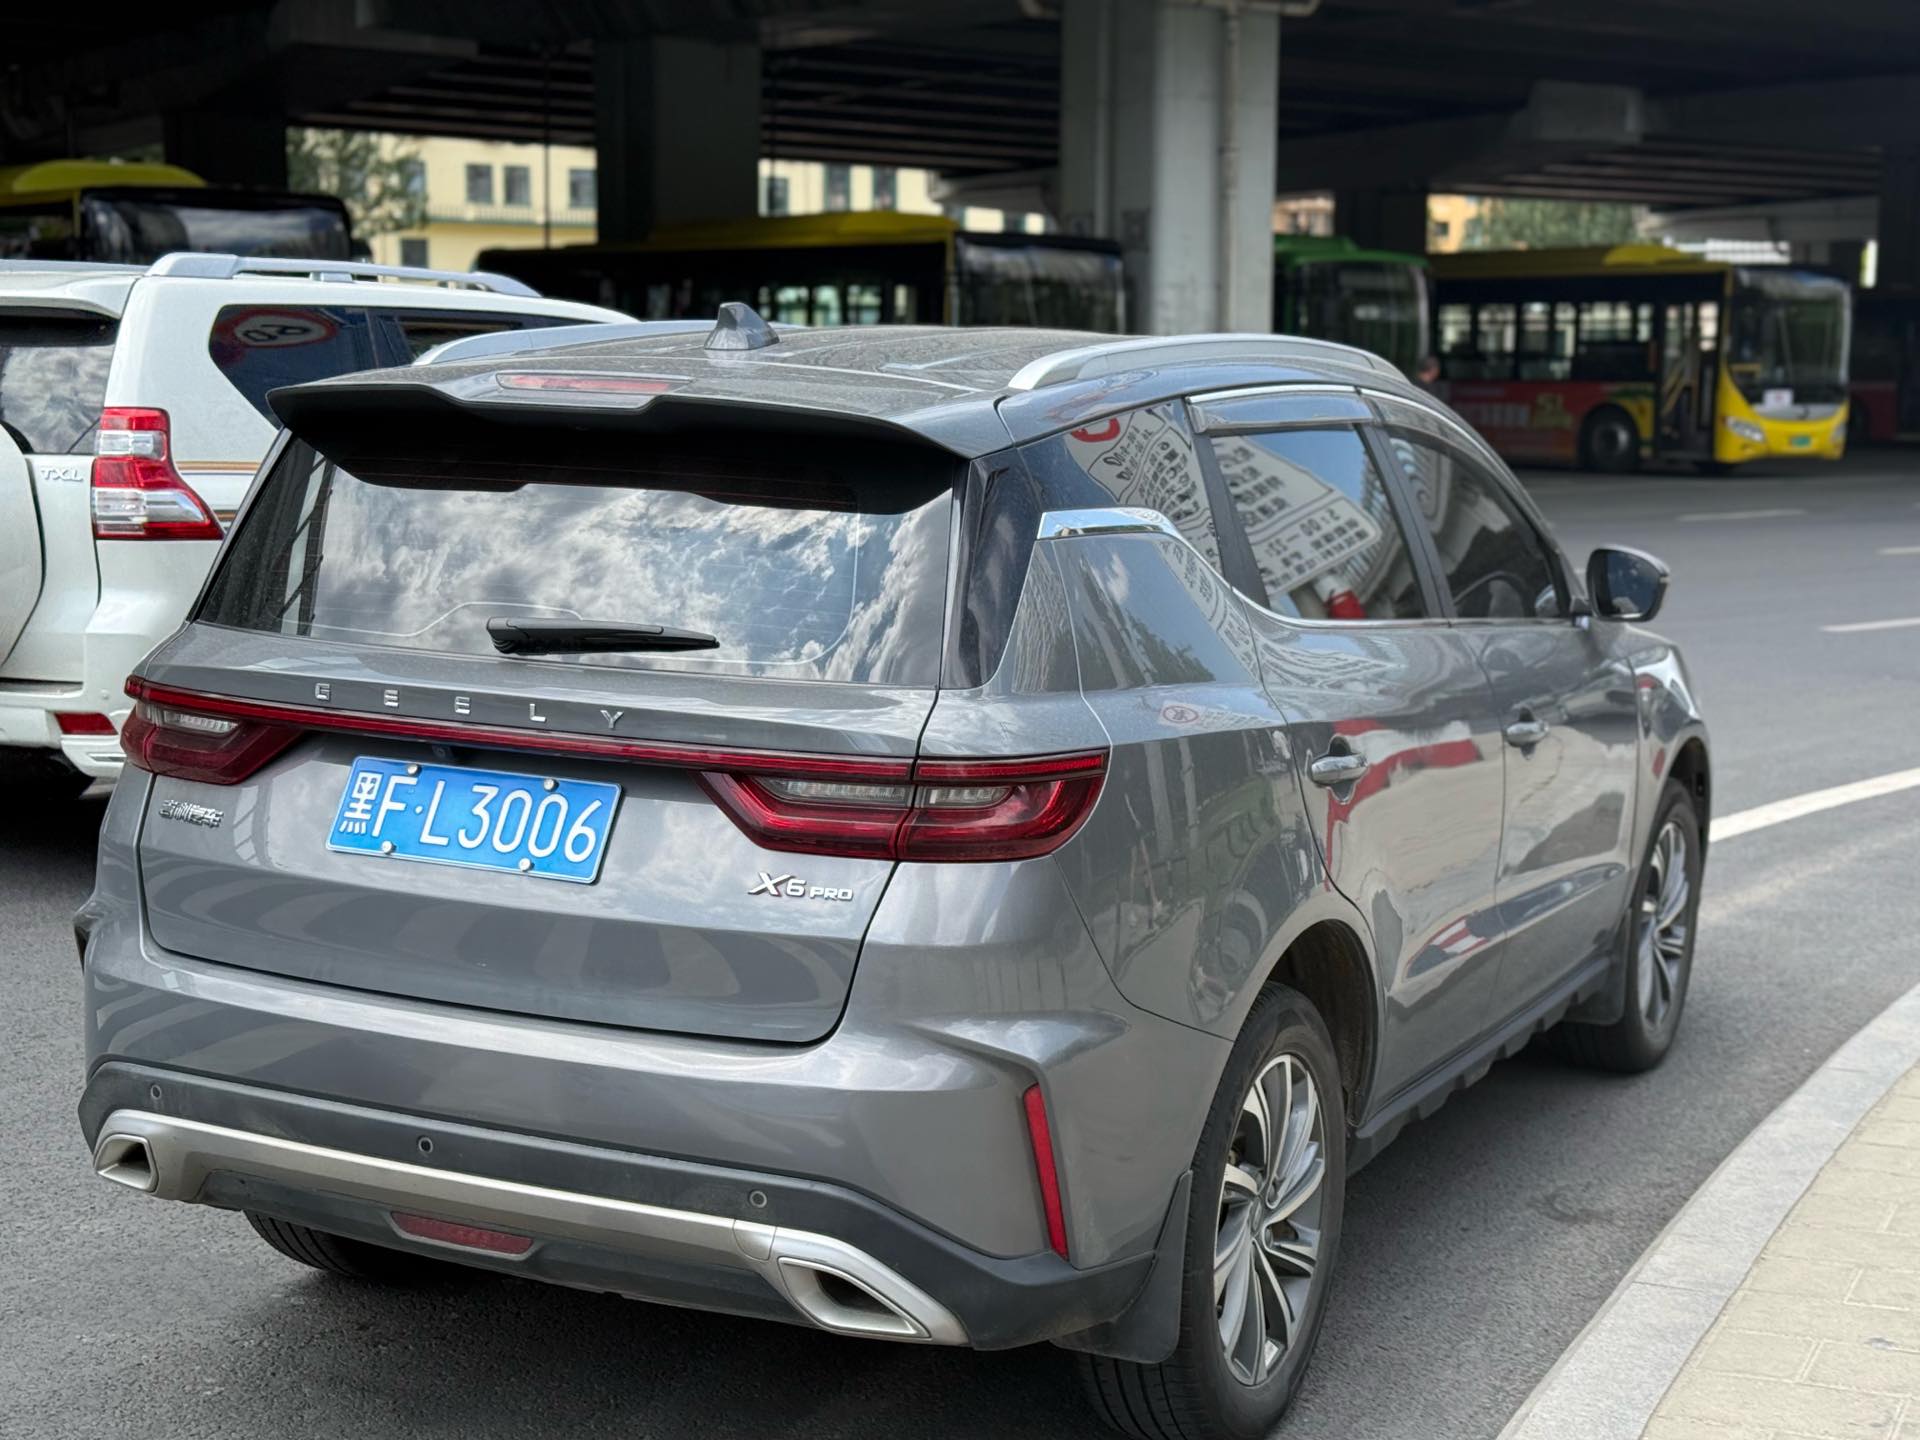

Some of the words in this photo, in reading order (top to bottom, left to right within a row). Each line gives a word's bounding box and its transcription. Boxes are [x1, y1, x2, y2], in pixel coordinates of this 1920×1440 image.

[40, 467, 84, 483] TXL
[315, 683, 624, 729] GEELY
[159, 800, 224, 829] 吉利汽车
[747, 872, 807, 898] X6
[809, 886, 854, 902] PRO
